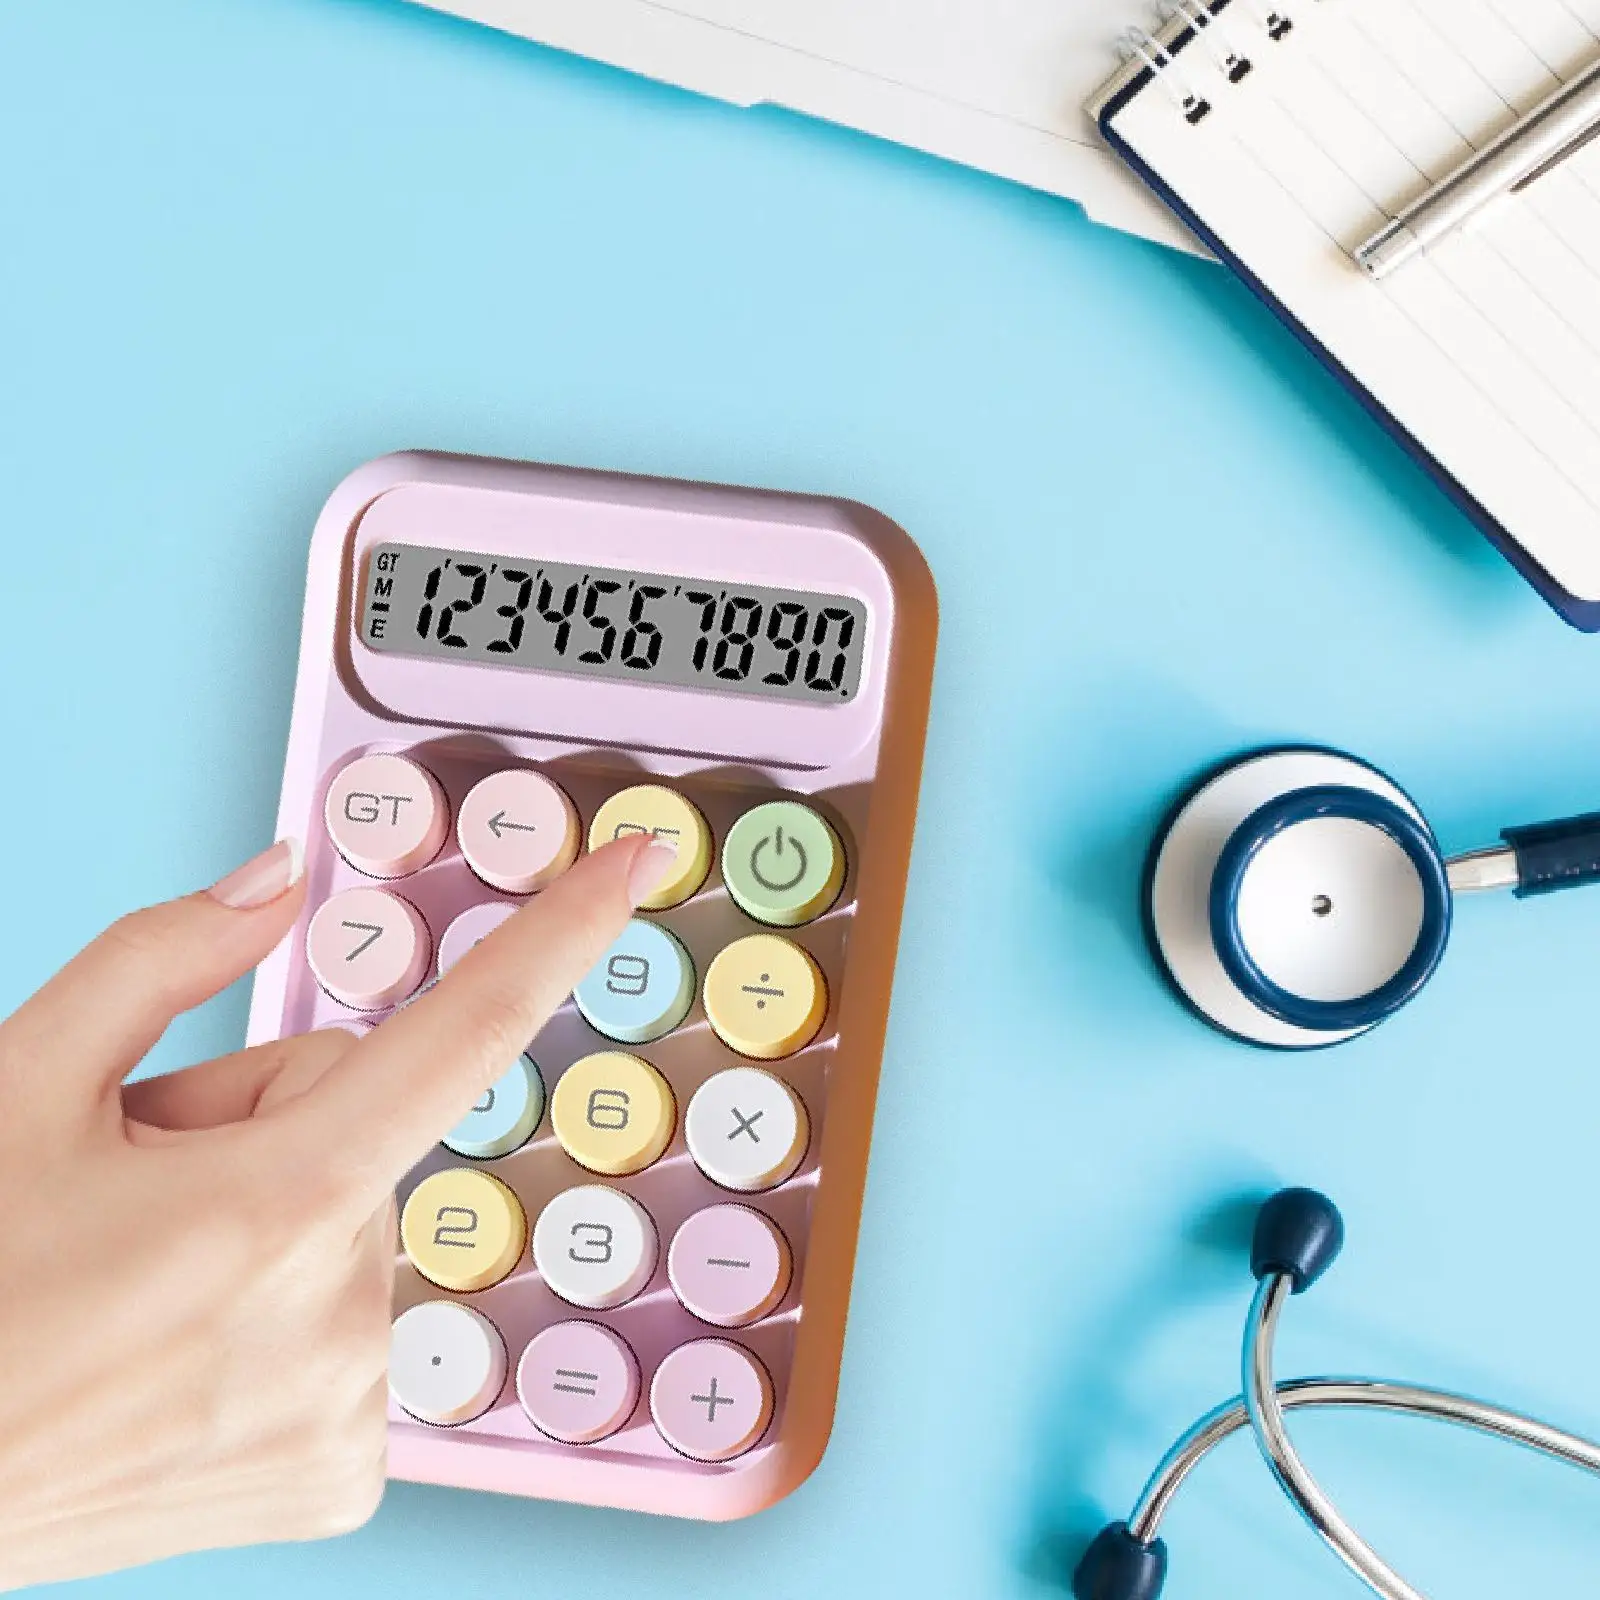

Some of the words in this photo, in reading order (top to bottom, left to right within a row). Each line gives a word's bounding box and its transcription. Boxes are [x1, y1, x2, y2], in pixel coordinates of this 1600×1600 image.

[377, 552, 401, 573] GT
[374, 577, 394, 597] M
[369, 618, 387, 639] E
[344, 791, 413, 826] GT
[341, 920, 384, 962] 7
[606, 954, 650, 996] 9
[586, 1088, 630, 1130] 6
[433, 1206, 478, 1249] 2
[568, 1222, 613, 1264] 3
